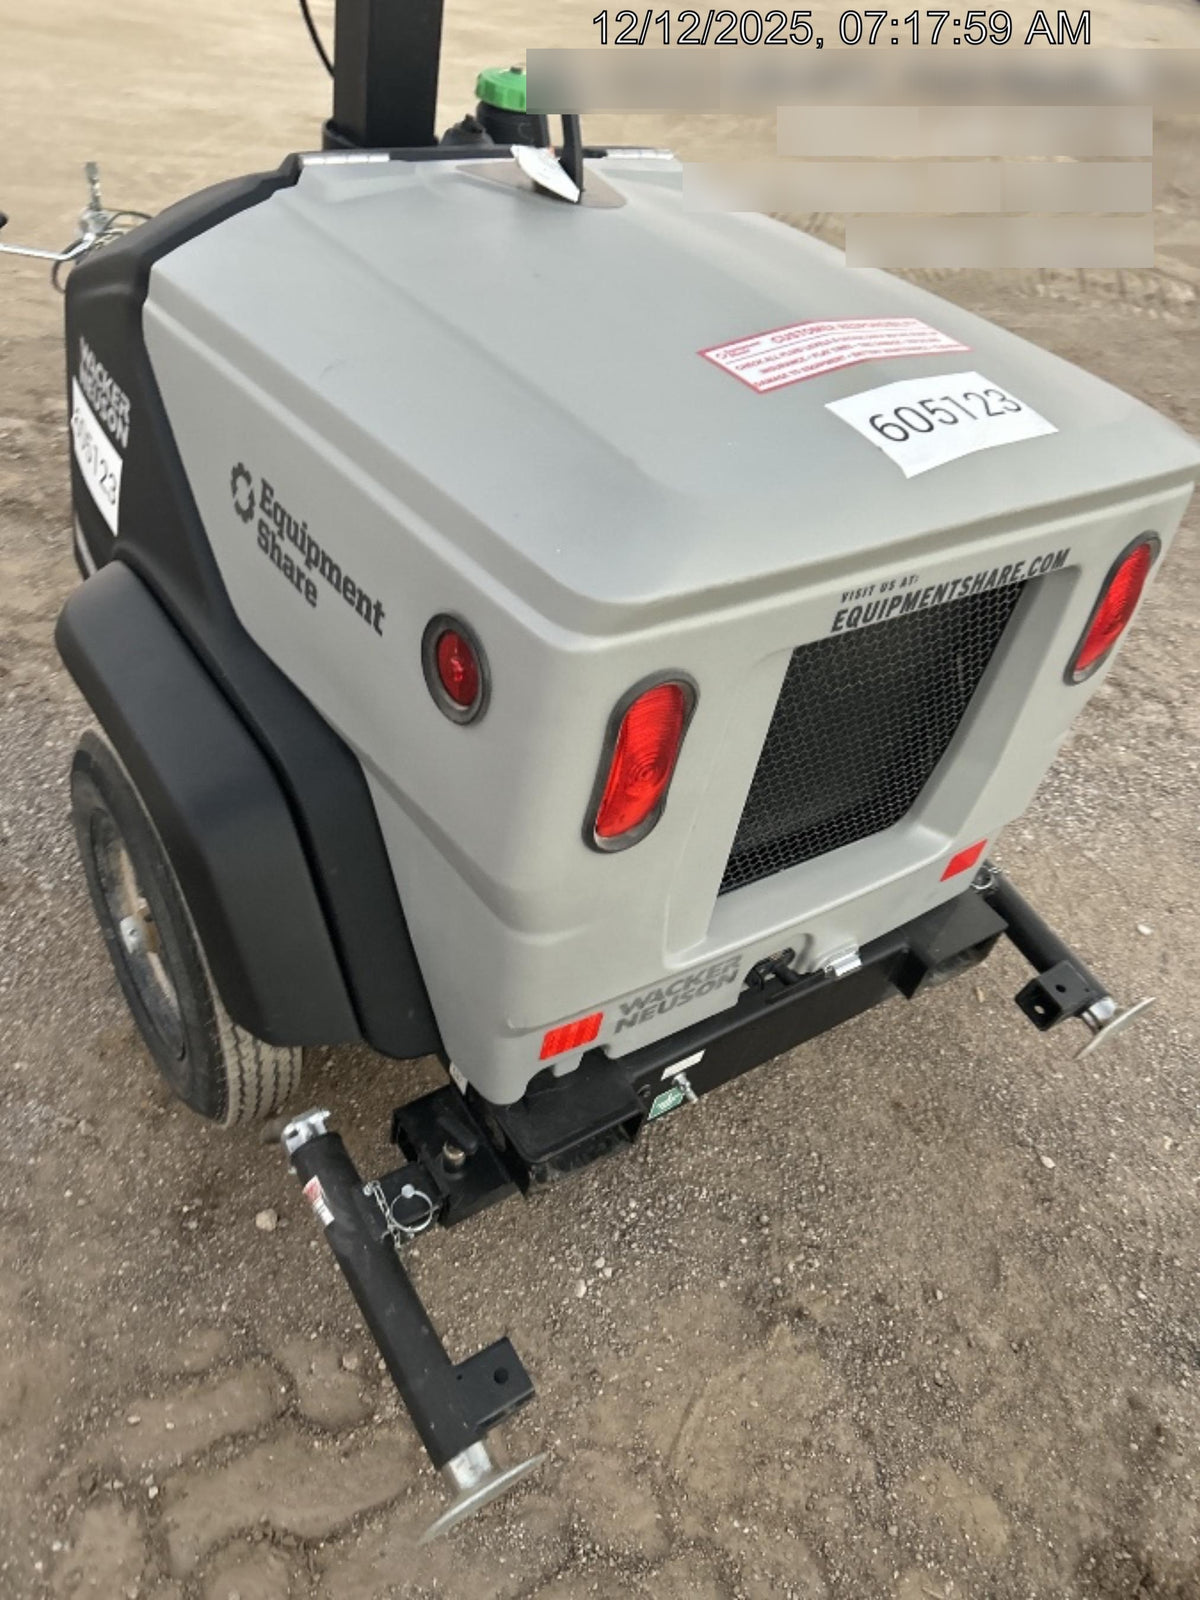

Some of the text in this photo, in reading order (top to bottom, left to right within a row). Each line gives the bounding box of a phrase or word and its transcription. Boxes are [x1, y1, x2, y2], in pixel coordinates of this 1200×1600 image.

[868, 388, 1022, 442] 605123
[257, 517, 318, 609] Share
[259, 477, 385, 637] Equipment
[830, 548, 1071, 633] EQUIPMENTSHARE.COM
[841, 584, 876, 603] VISIT
[879, 580, 896, 594] US
[614, 970, 739, 1034] NEUSON
[619, 954, 743, 1016] WACKER
